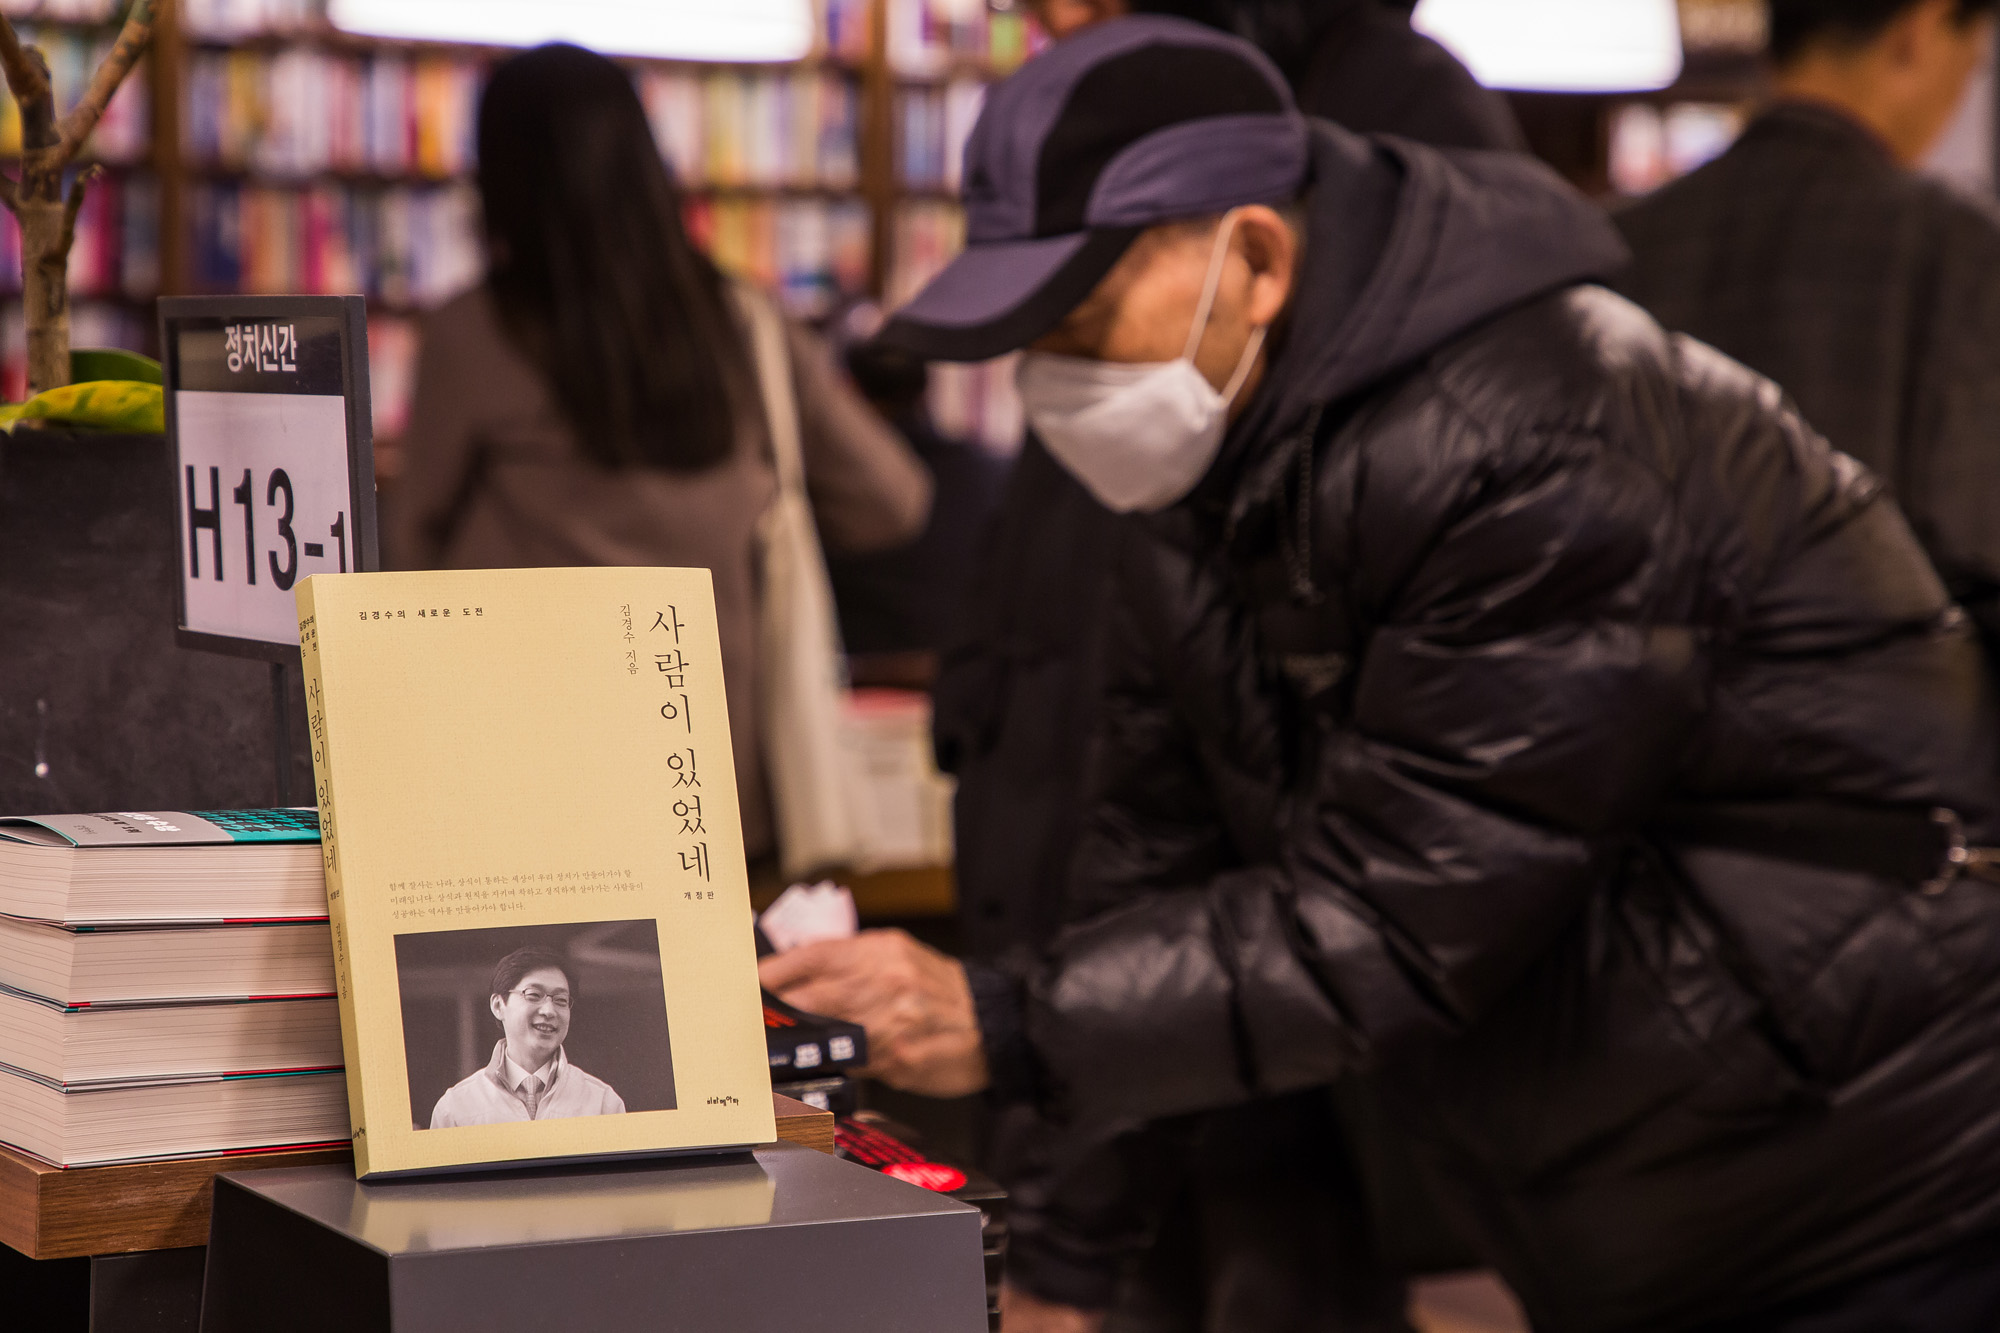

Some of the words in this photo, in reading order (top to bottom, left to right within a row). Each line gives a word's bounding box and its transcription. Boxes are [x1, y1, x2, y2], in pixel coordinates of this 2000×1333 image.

[224, 323, 297, 372] 정치신간
[185, 464, 347, 592] H13-1
[359, 610, 406, 620] 김경수의
[417, 608, 451, 618] 새로운
[462, 607, 483, 616] 도전
[620, 604, 635, 644] 김경수
[625, 649, 639, 675] 지음
[649, 604, 690, 734] 사람이
[308, 678, 326, 769] 사람이
[318, 779, 337, 873] 있었네
[667, 747, 710, 882] 있었네
[684, 891, 714, 900] 개정판
